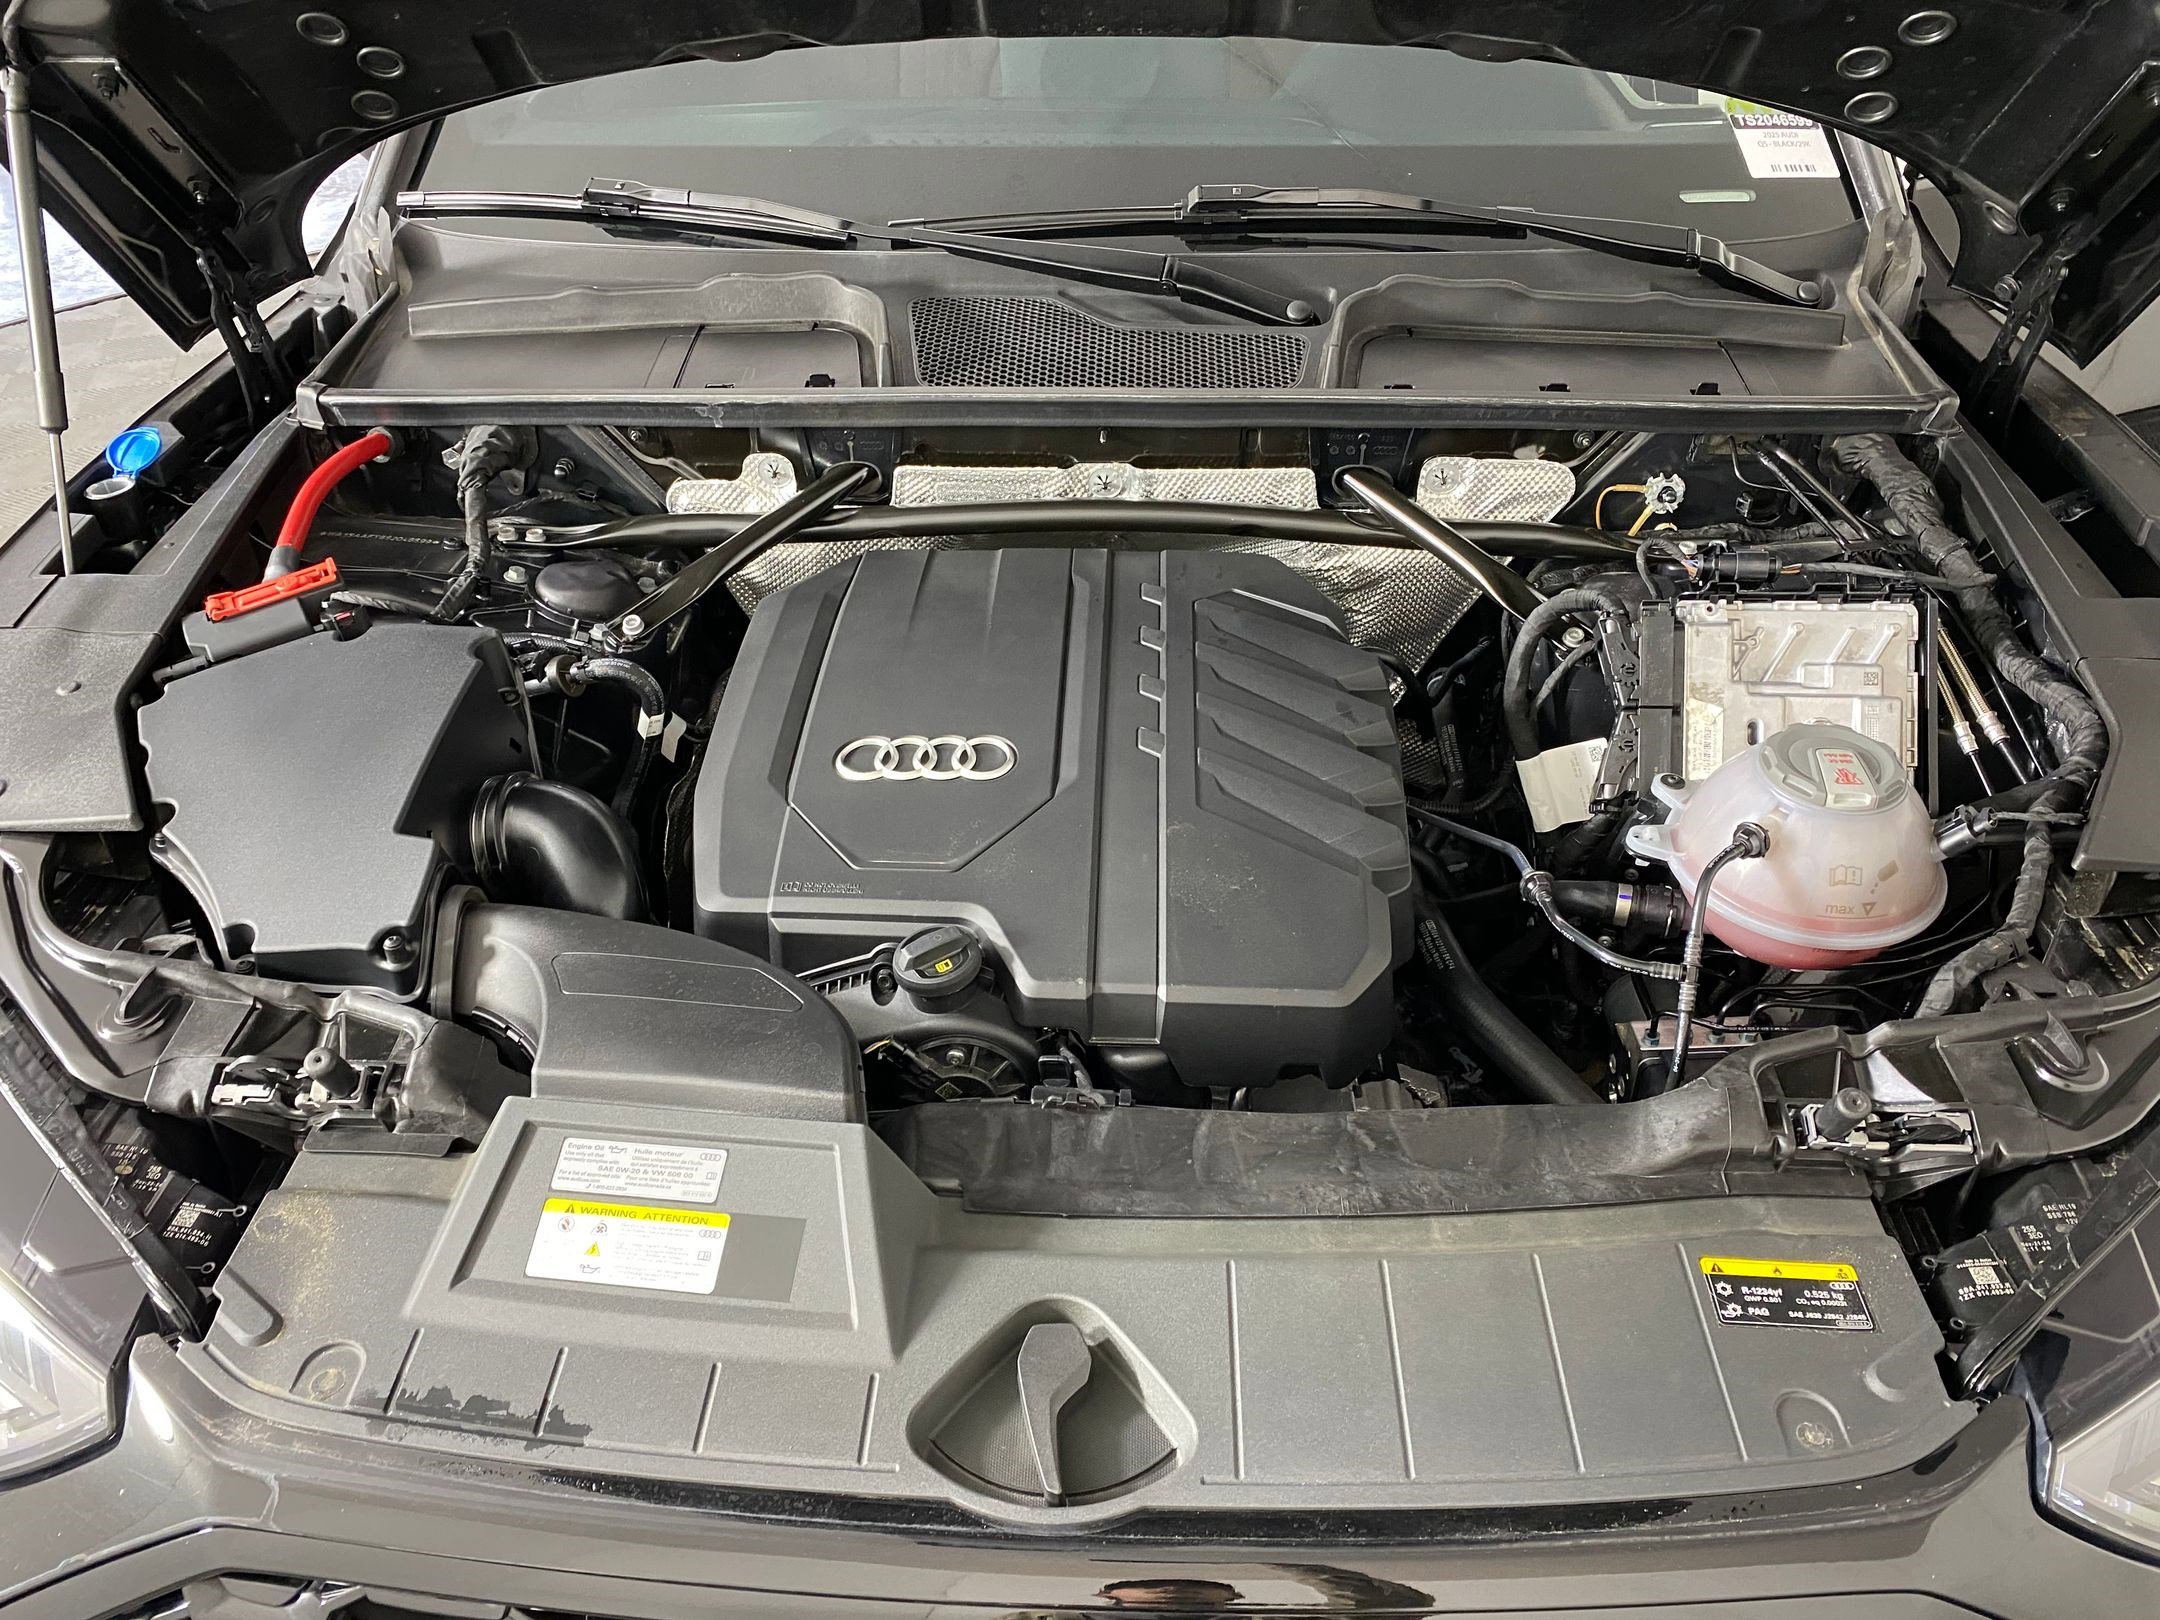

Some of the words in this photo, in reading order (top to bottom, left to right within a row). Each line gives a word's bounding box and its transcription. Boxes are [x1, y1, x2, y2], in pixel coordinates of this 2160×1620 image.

[1735, 114, 1813, 127] TS2046599
[1825, 902, 1855, 915] max
[568, 1142, 592, 1151] Engine
[655, 1150, 683, 1158] moteur
[615, 1166, 641, 1174] 0W-20
[580, 1206, 637, 1219] WARNING
[643, 1212, 709, 1225] ATTENTION
[1740, 1286, 1783, 1297] R-1234yf
[1804, 1290, 1830, 1300] 0.525
[1831, 1291, 1844, 1301] kg
[1744, 1295, 1763, 1303] GWP
[1748, 1307, 1770, 1316] PAG
[1788, 1311, 1803, 1319] SAE
